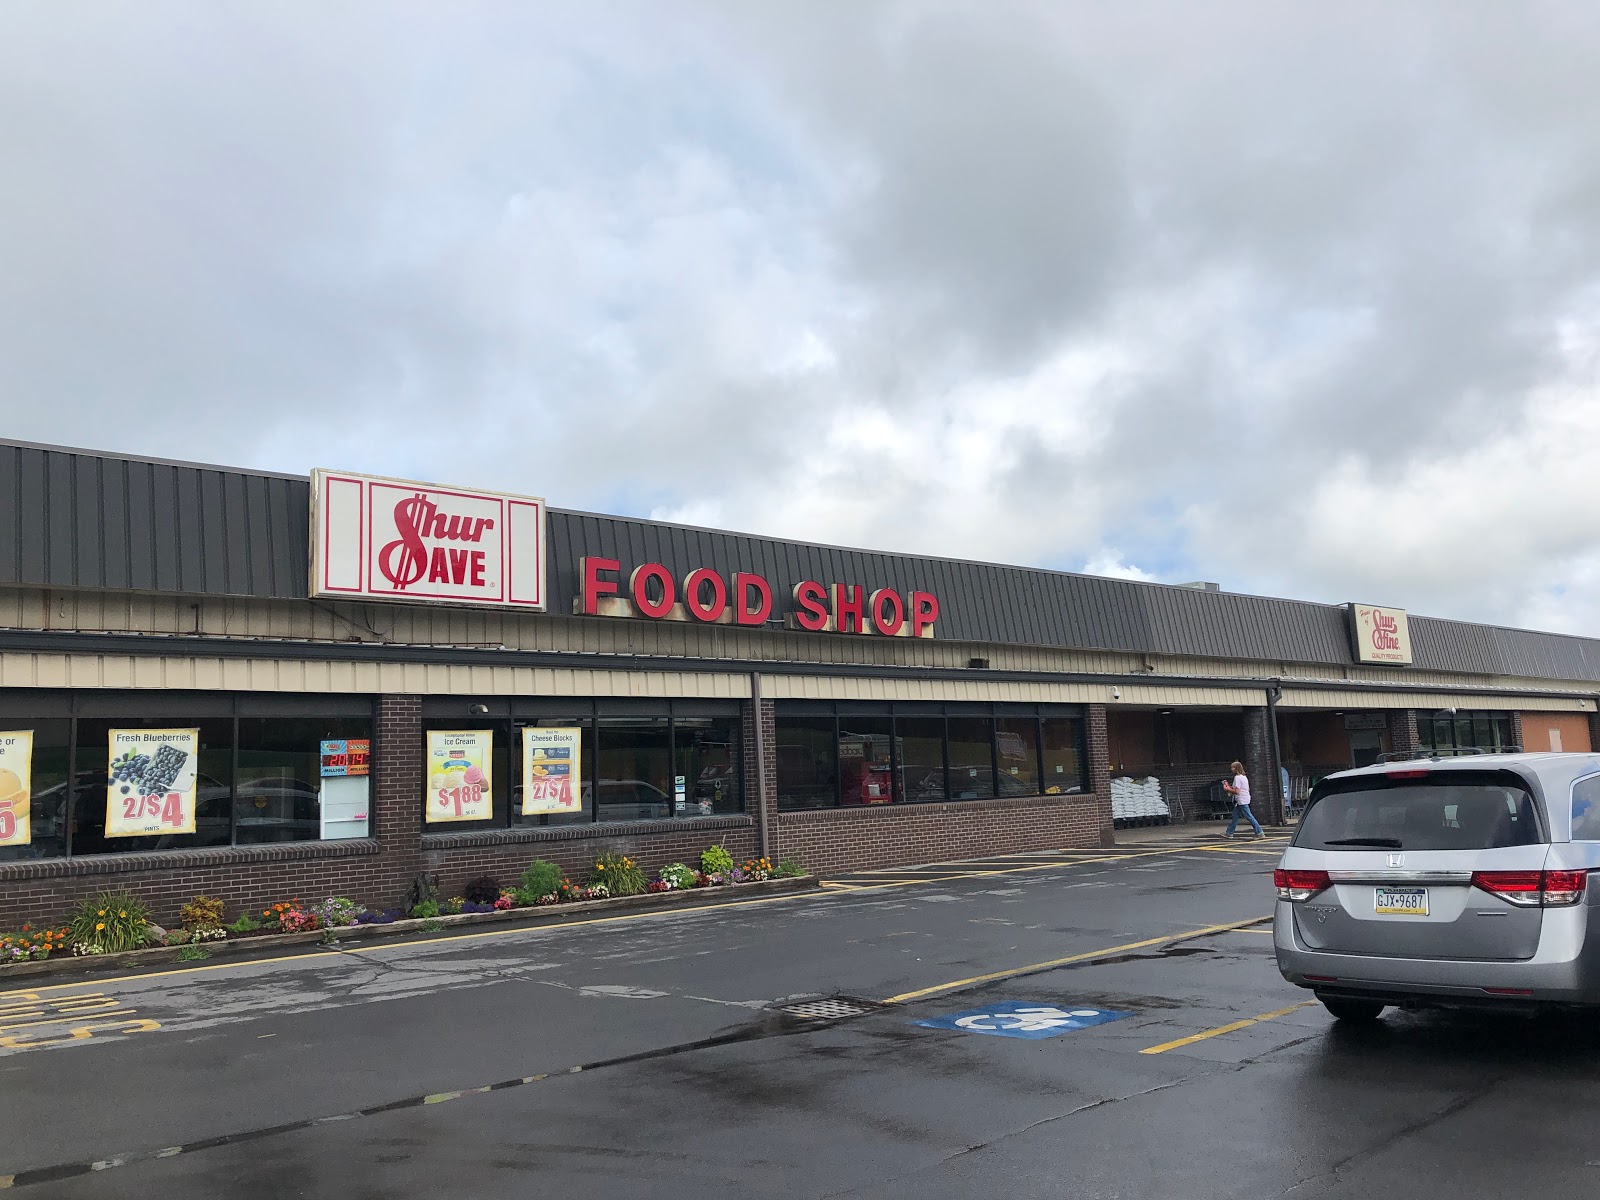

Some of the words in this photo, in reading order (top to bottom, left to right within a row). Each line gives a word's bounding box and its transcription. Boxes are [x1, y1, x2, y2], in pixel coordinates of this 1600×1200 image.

[584, 557, 773, 626] FOOD
[794, 581, 940, 637] SHOP
[5, 738, 15, 746] or
[116, 733, 141, 742] Fresh
[143, 733, 191, 742] Blueberries
[329, 754, 347, 767] 20
